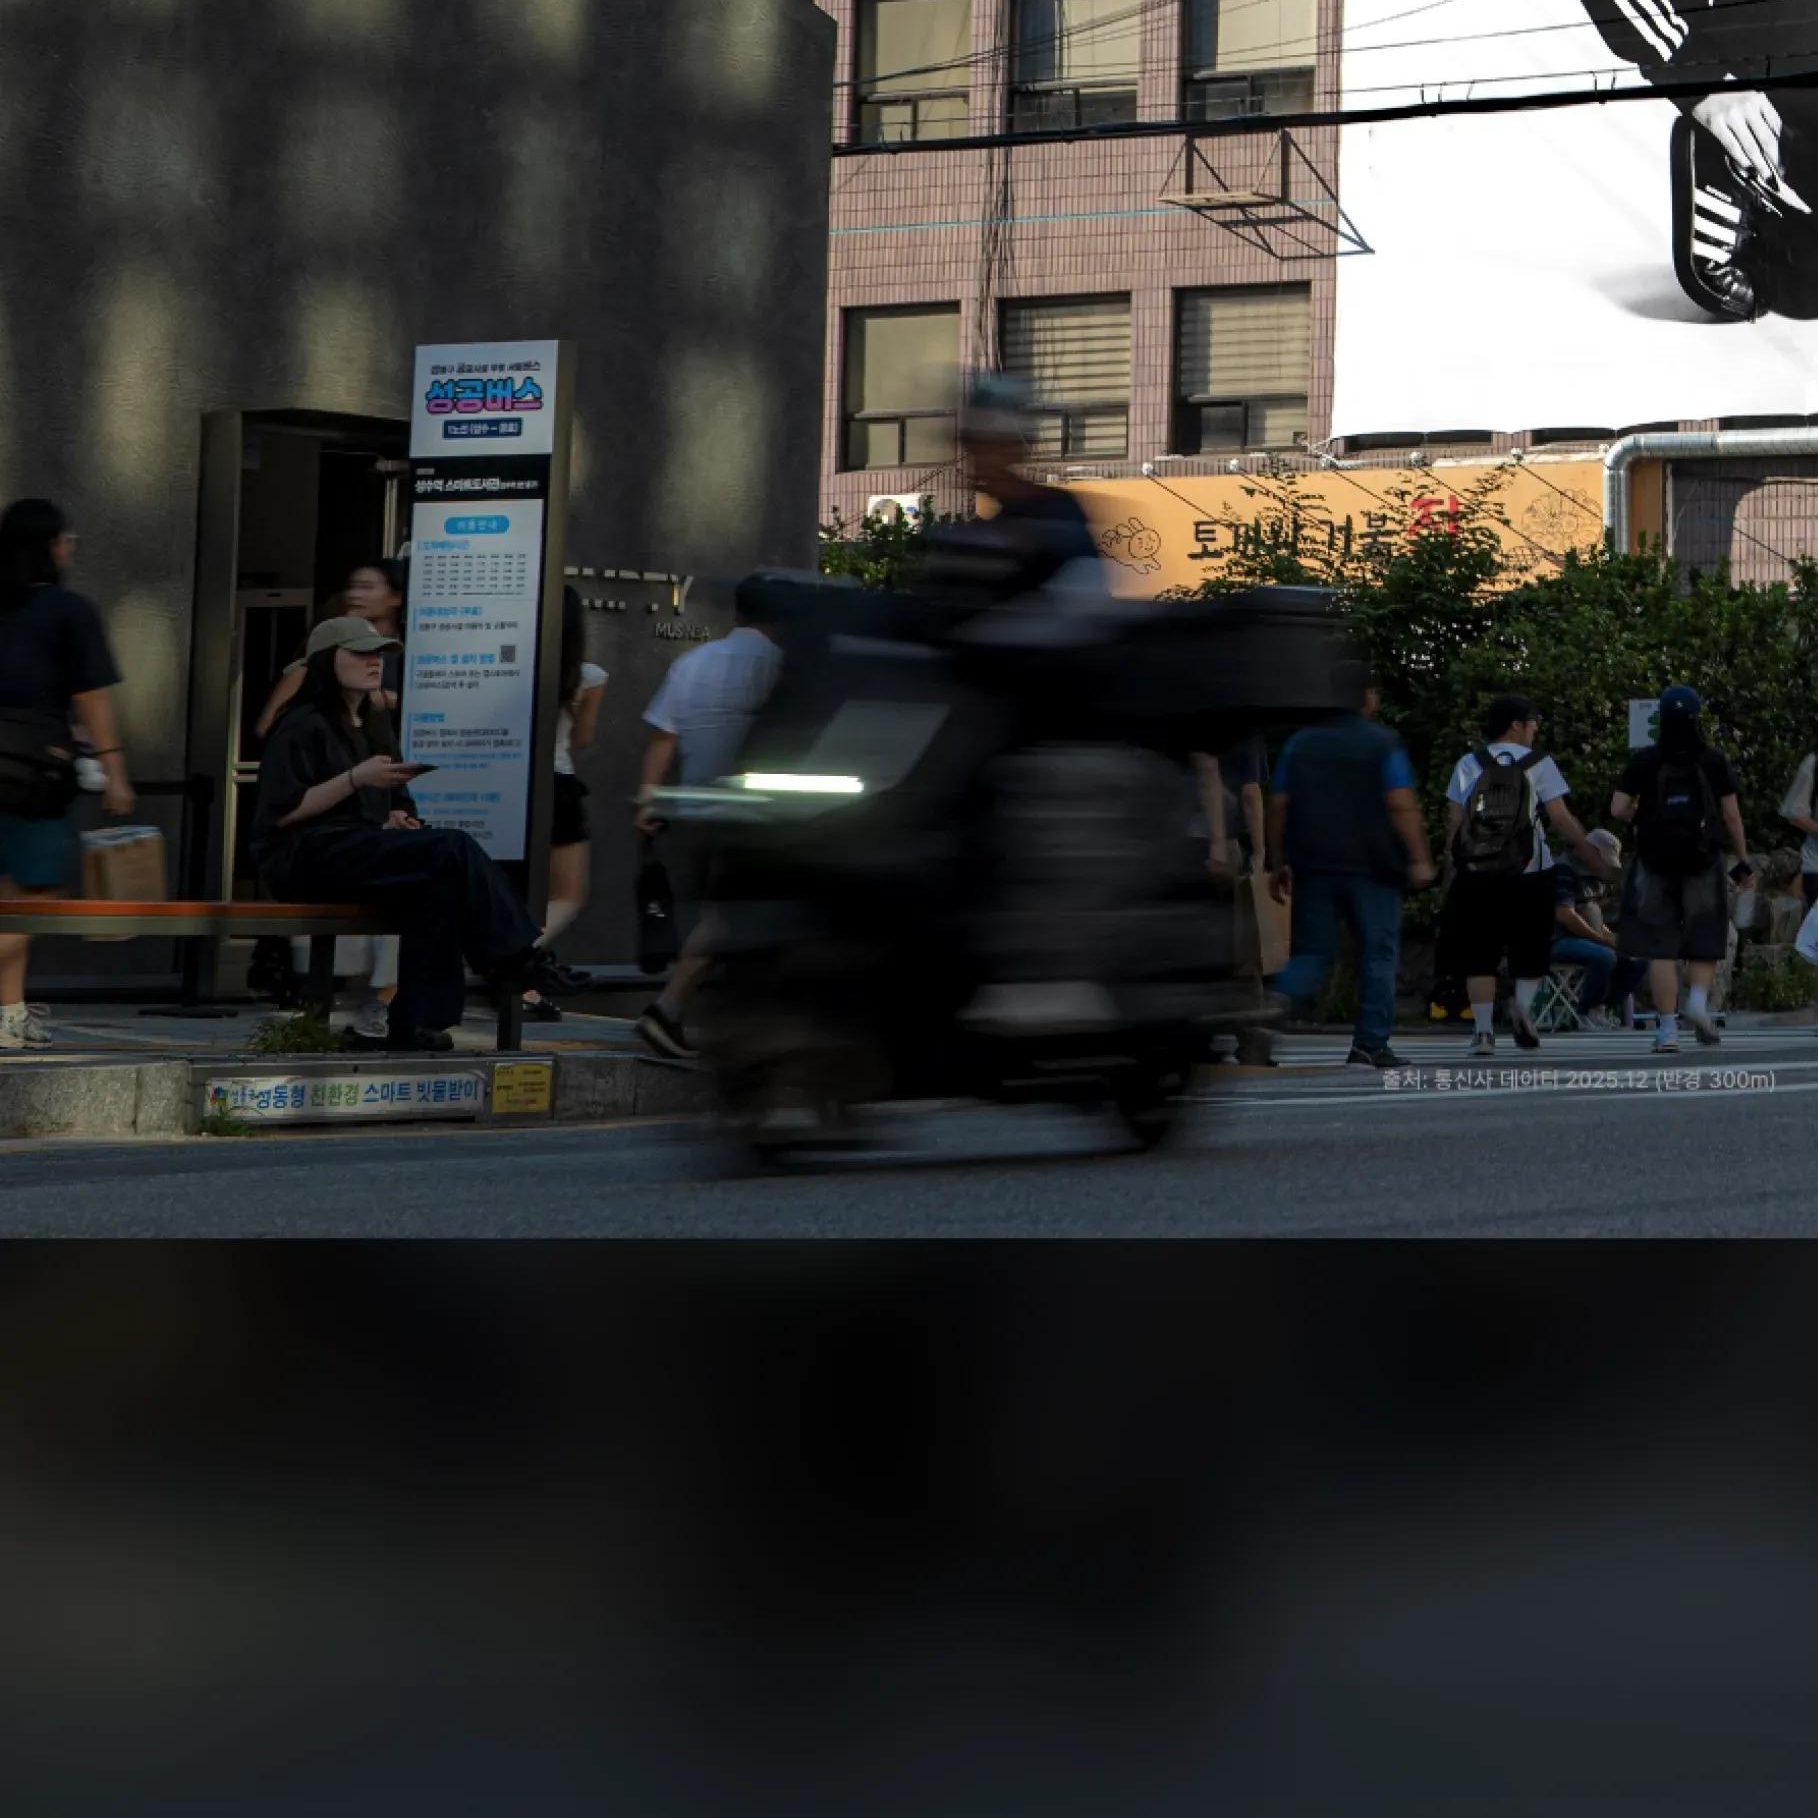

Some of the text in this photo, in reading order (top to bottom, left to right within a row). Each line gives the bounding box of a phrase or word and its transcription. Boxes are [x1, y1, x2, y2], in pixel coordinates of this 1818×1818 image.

[425, 376, 544, 414] 성공버스
[257, 1085, 306, 1109] 성동형
[310, 1083, 360, 1107] 친환경
[363, 1081, 411, 1103] 스마트
[416, 1079, 479, 1102] 빗물받이
